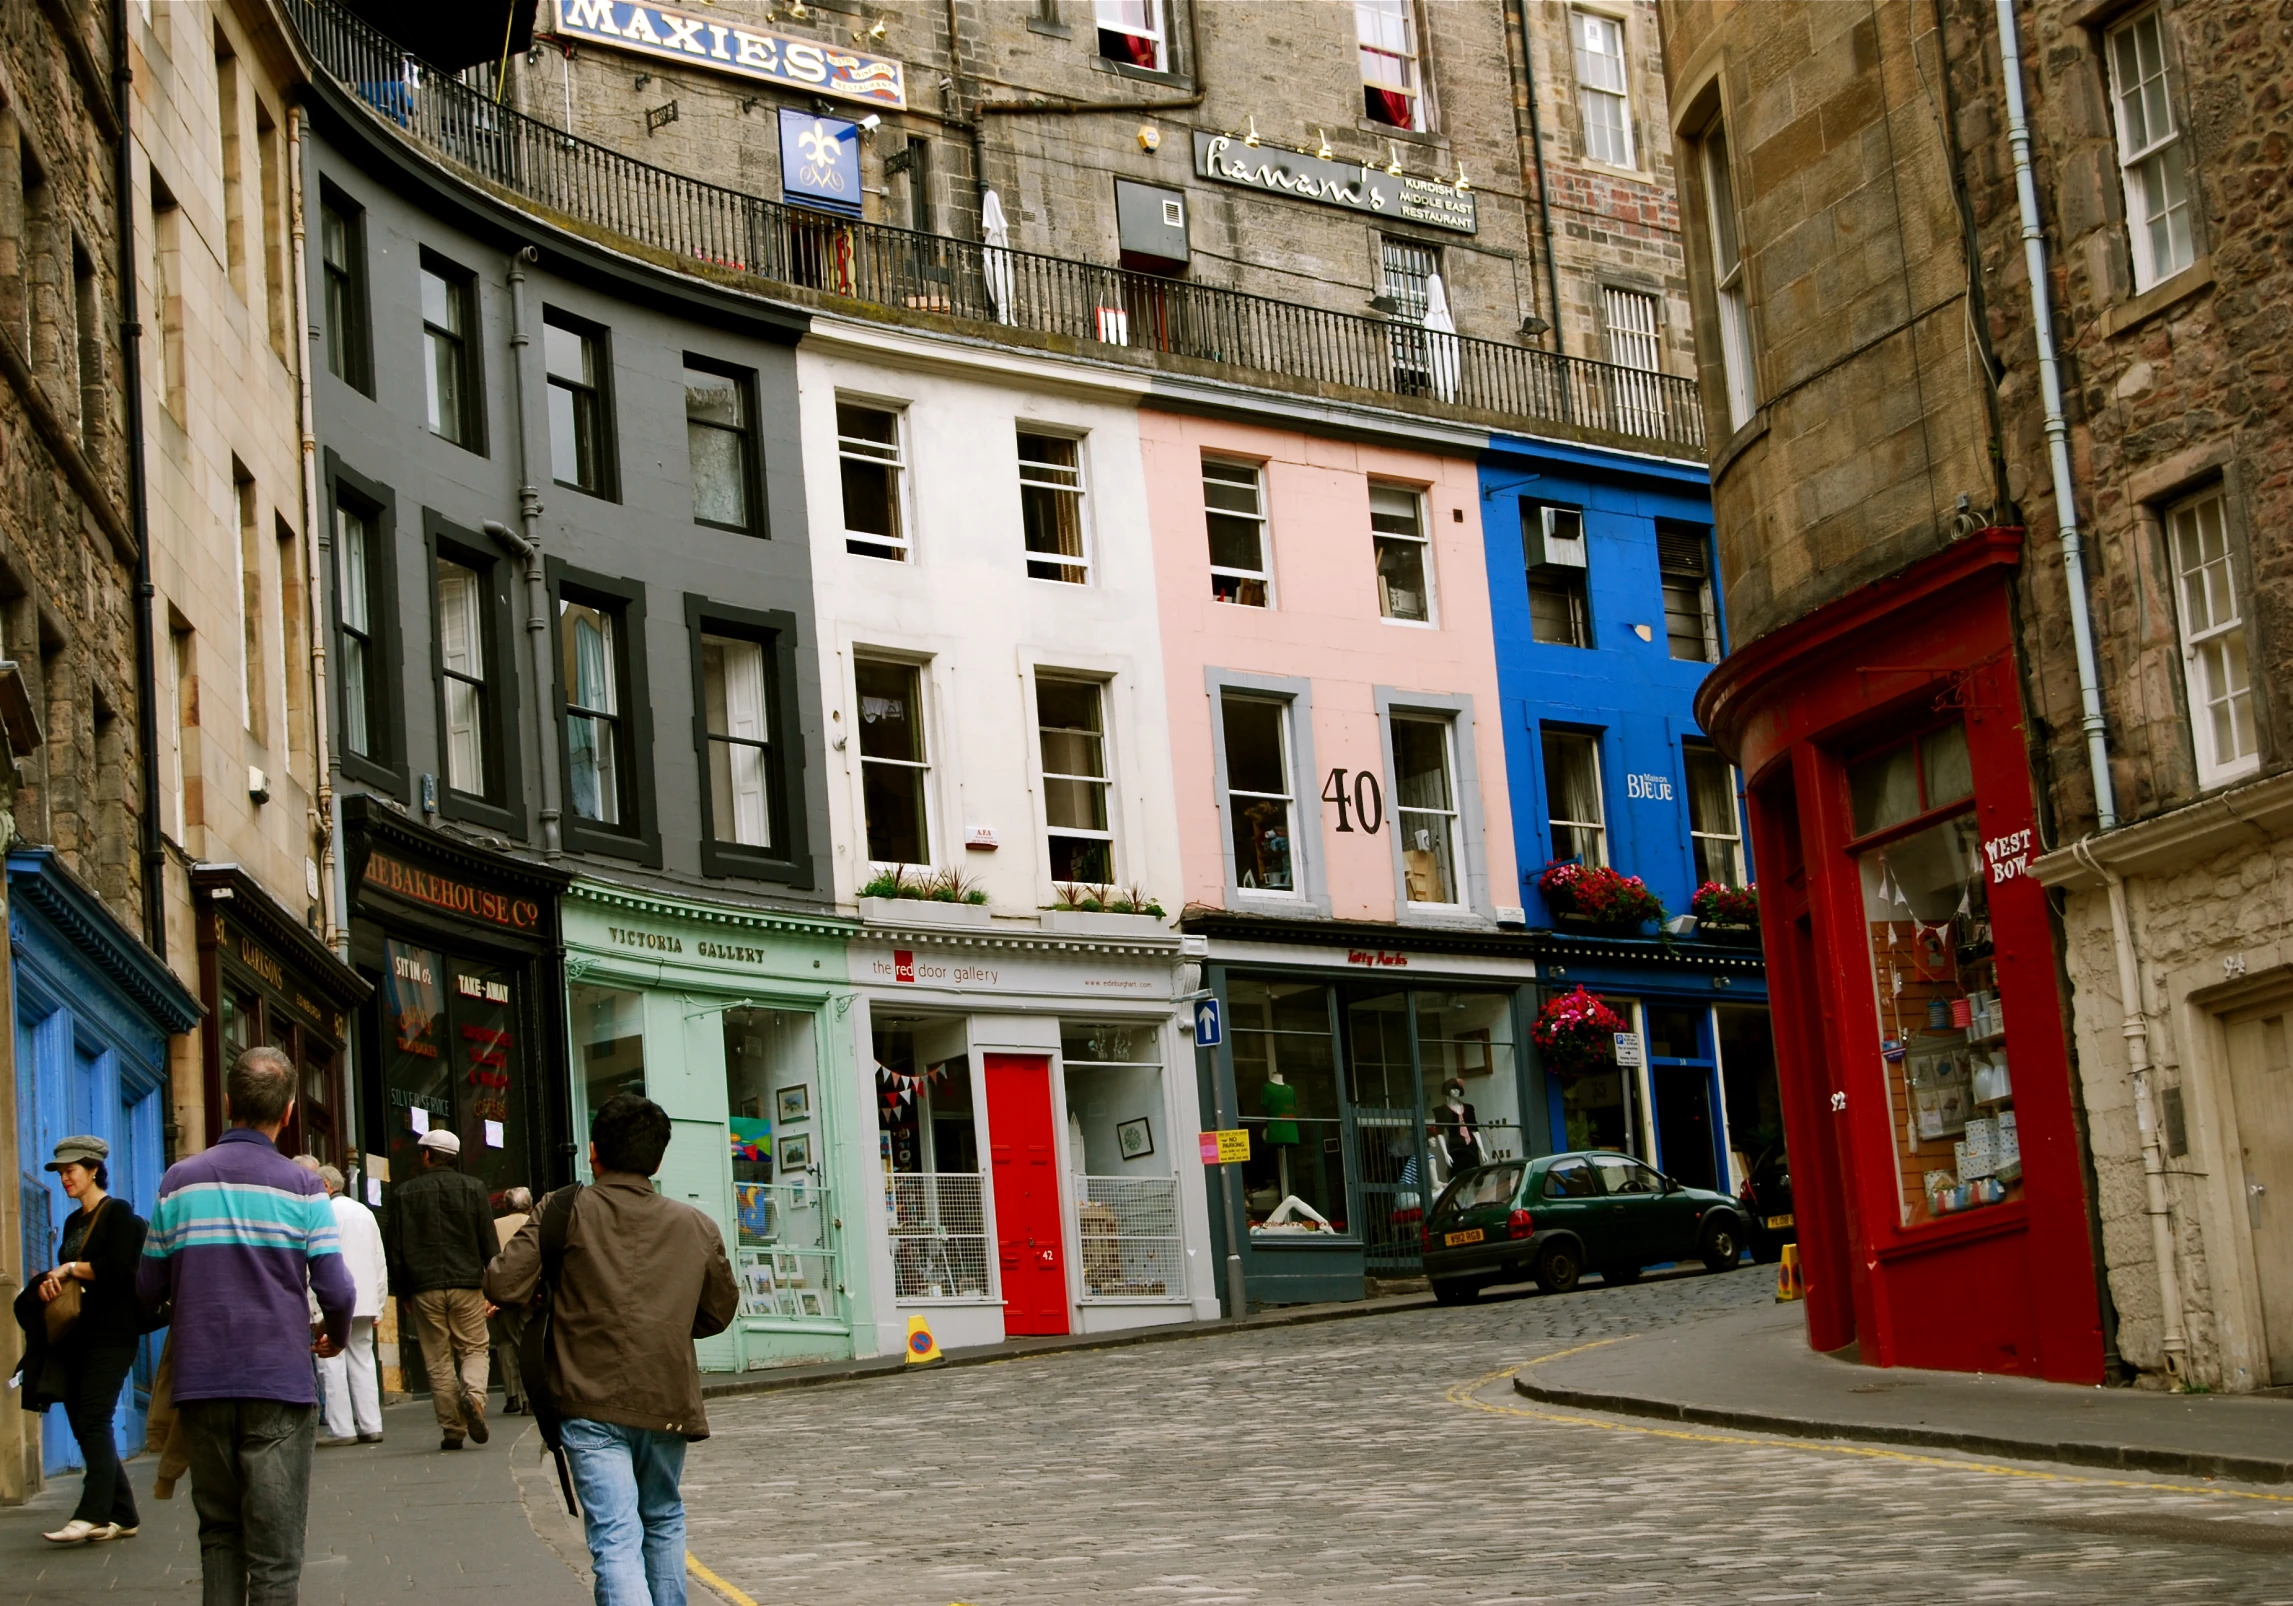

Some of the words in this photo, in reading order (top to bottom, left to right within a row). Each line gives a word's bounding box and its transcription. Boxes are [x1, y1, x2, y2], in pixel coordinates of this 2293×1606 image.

[566, 0, 827, 83] MAXIES
[854, 68, 873, 78] WINE
[874, 64, 891, 74] BAR
[836, 81, 893, 91] RESTAURANT
[1404, 178, 1453, 197] KURDISH
[1399, 191, 1442, 209] MIDDLE
[1444, 201, 1473, 215] EAST
[1401, 206, 1472, 228] RESTAURANT
[1320, 767, 1382, 835] 40
[1984, 828, 2031, 864] WEST
[1991, 852, 2028, 884] BOW
[365, 852, 389, 885] HE
[391, 860, 509, 924] BAKEHOUSE
[609, 926, 683, 953] VICTORIA
[697, 941, 765, 964] GALLERY
[241, 937, 283, 990] CLARKSONS
[395, 956, 410, 978] SIT
[410, 960, 421, 982] IN
[872, 960, 892, 974] the
[896, 963, 914, 977] red
[918, 963, 947, 977] door
[953, 966, 998, 985] gallery
[2223, 952, 2246, 977] 94
[391, 1088, 420, 1107] SILVER
[421, 1095, 451, 1117] SERVICE
[1830, 1091, 1846, 1111] 92
[1222, 1141, 1245, 1149] PARKING
[1042, 1250, 1054, 1261] 42
